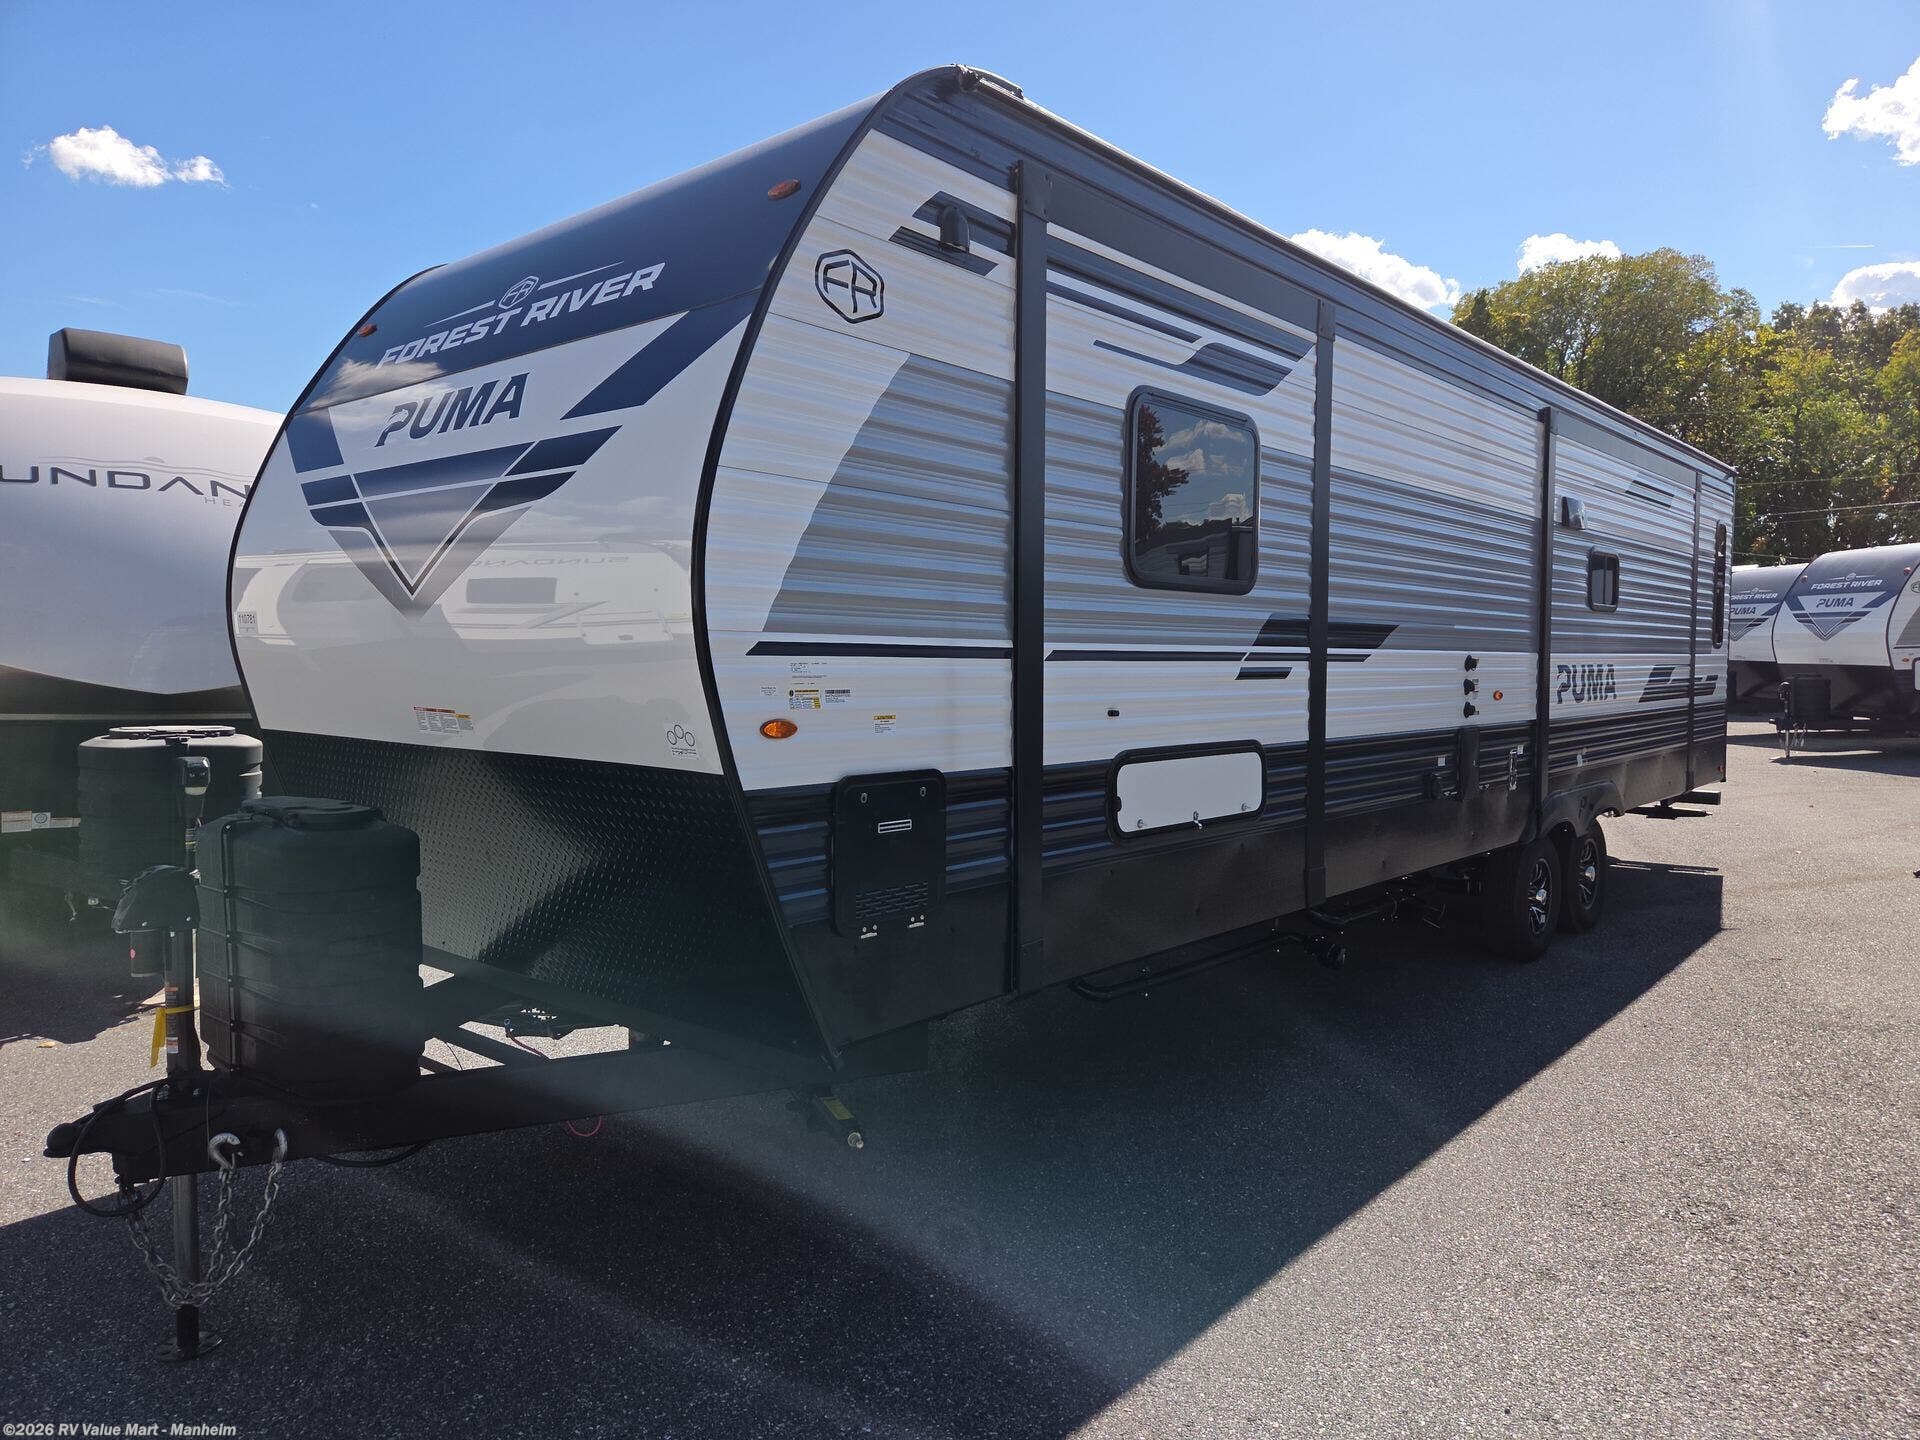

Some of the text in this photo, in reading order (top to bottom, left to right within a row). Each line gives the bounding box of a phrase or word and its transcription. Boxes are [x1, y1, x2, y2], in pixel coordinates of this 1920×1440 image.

[376, 263, 665, 369] FOREST RIVER
[375, 372, 530, 447] PUMA
[0, 465, 251, 500] UNDAN
[1754, 592, 1778, 600] RIVER
[1811, 579, 1883, 590] FOREST RIVER
[1816, 597, 1854, 608] PUMA
[1557, 664, 1617, 704] PUMA
